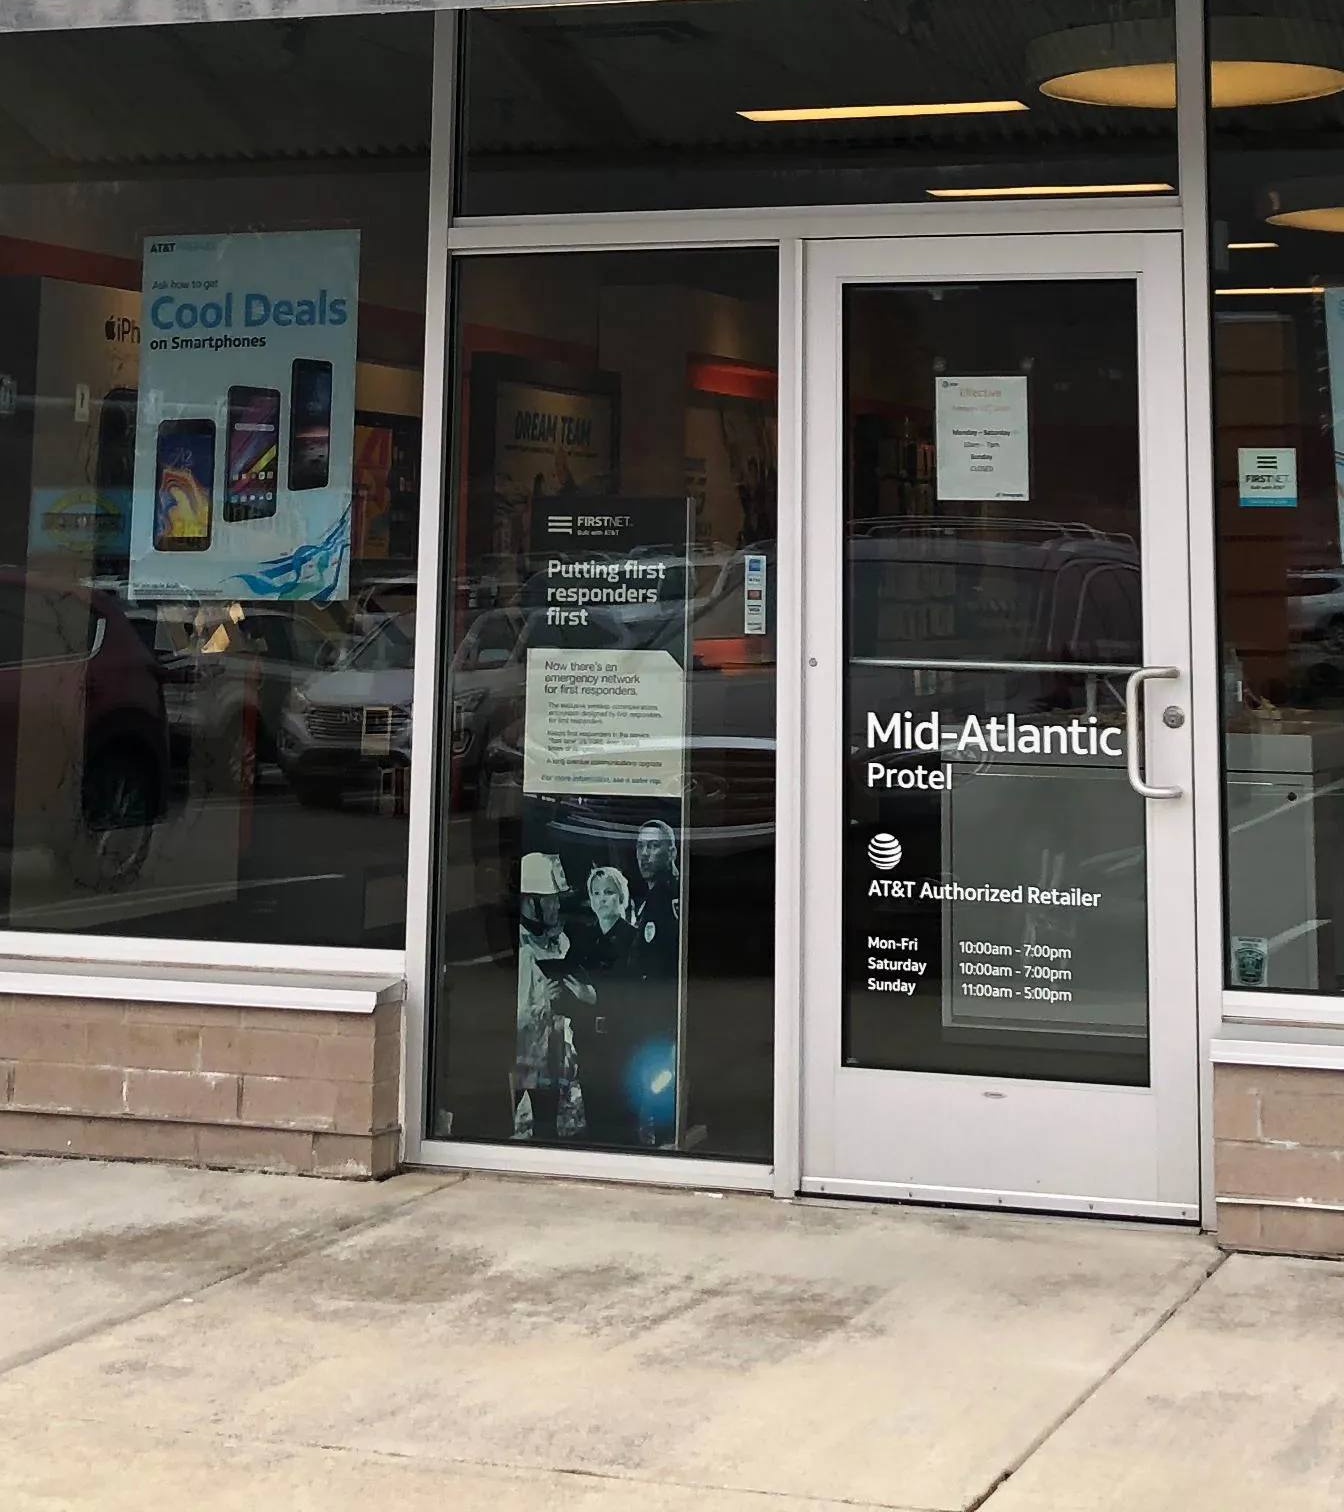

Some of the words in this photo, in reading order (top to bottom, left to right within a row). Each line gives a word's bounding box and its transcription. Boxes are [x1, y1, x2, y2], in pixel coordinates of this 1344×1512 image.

[150, 243, 176, 253] AT&T
[171, 280, 190, 289] how
[192, 279, 202, 288] to
[203, 279, 219, 290] get
[151, 292, 233, 330] Cool
[244, 289, 347, 327] Deals
[150, 338, 167, 350] on
[171, 335, 266, 351] Smartphones
[516, 410, 557, 444] DREAM
[561, 416, 591, 446] TEAM
[1245, 474, 1290, 484] FIRSTET
[548, 560, 620, 582] Putting
[624, 560, 666, 579] first
[547, 583, 657, 606] responders
[546, 606, 588, 625] first
[545, 661, 567, 671] Now
[570, 661, 602, 672] there's
[605, 663, 617, 671] an
[544, 675, 599, 685] emergency
[601, 674, 640, 684] network
[544, 684, 557, 694] for
[560, 684, 578, 694] first
[581, 685, 638, 696] responders.
[867, 711, 1123, 756] Mid-Atlantic
[867, 762, 953, 790] Protel
[868, 879, 916, 898] AT&T
[920, 882, 1023, 903] Authorized
[1027, 886, 1102, 907] Retailer
[867, 936, 918, 951] Mon-Fri
[959, 941, 1013, 956] 10:00am
[1023, 944, 1072, 961] 7:00pm
[867, 957, 927, 975] Saturday
[959, 962, 1013, 978] 10:00am
[1024, 965, 1072, 982] 7:00pm
[867, 978, 916, 996] Sunday
[961, 983, 1013, 999] 11:00am
[1024, 987, 1072, 1004] 5:00pm
